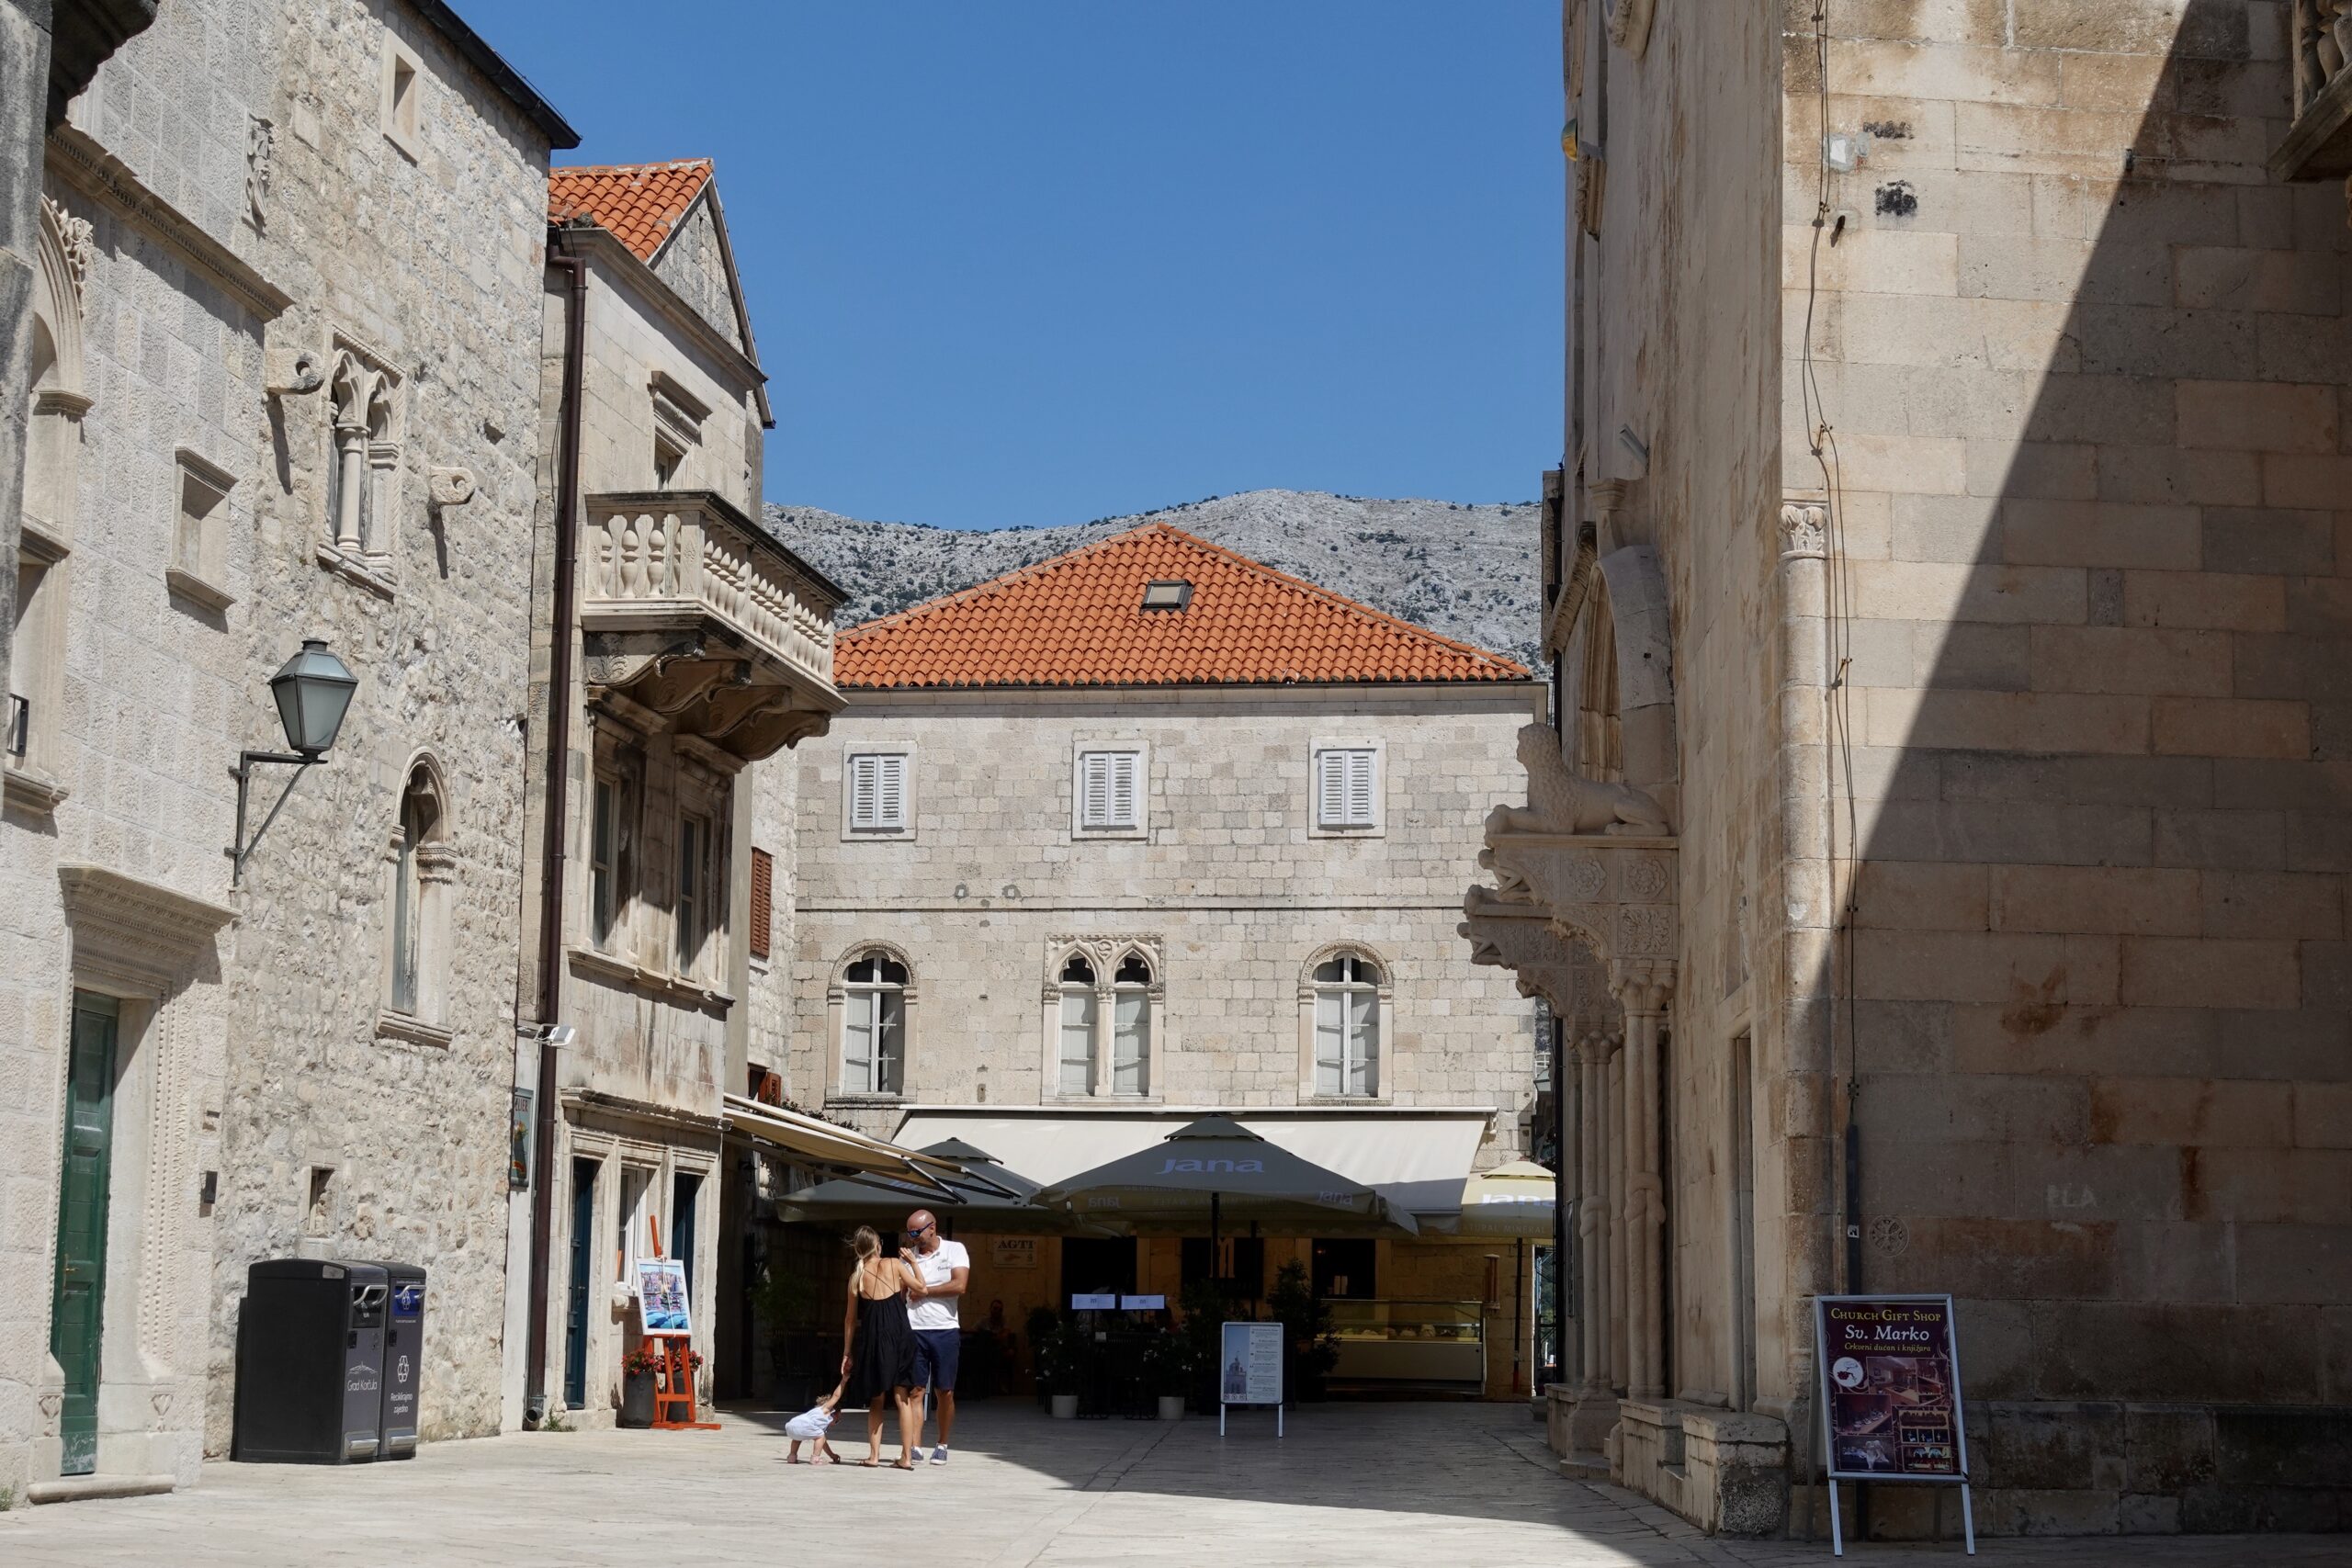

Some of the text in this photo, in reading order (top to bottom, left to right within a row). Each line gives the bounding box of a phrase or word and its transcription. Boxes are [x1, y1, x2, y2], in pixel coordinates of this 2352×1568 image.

[1502, 1225, 1545, 1234] MINERAL
[1830, 1307, 1941, 1322] CHURCH GIFT SHOP
[1845, 1325, 1930, 1341] Sv. Marko
[1844, 1342, 1872, 1351] Crkveni
[1873, 1343, 1896, 1352] dućan
[1902, 1344, 1931, 1354] knjižara
[347, 1378, 378, 1391] Grad Korčula
